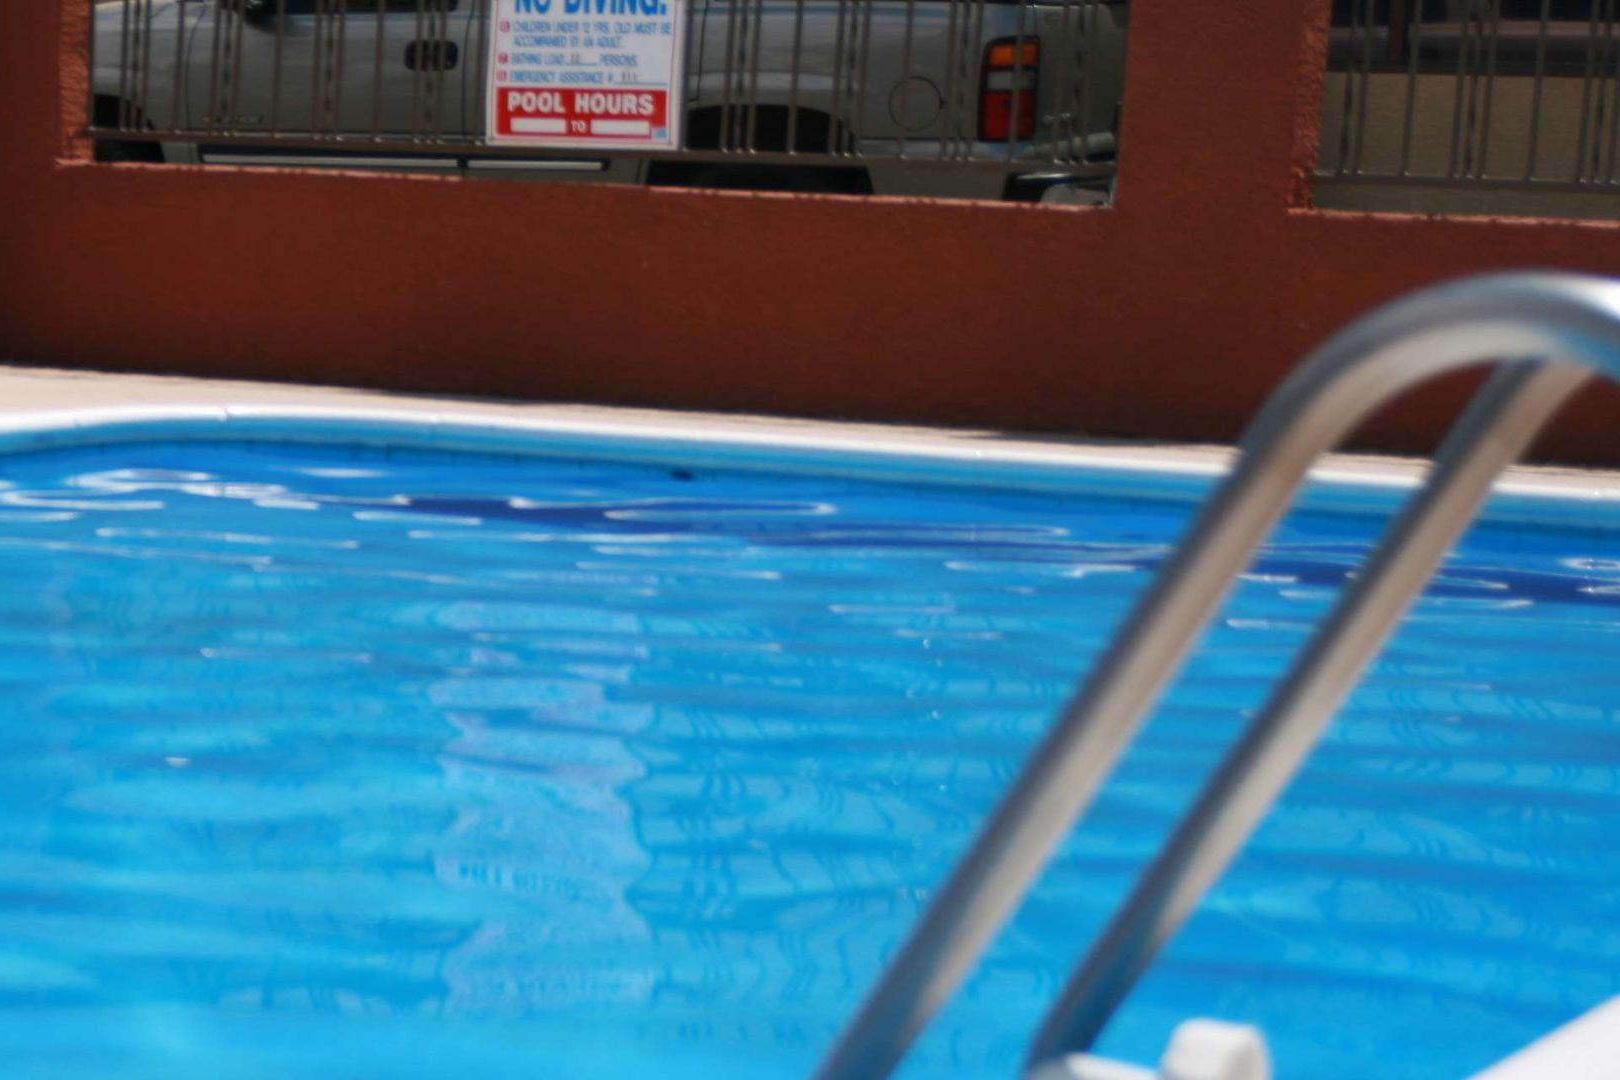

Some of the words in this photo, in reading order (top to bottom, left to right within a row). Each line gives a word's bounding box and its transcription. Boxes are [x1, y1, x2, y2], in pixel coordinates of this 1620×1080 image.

[507, 91, 566, 113] POOL
[574, 93, 655, 116] HOURS
[571, 120, 586, 133] TO
